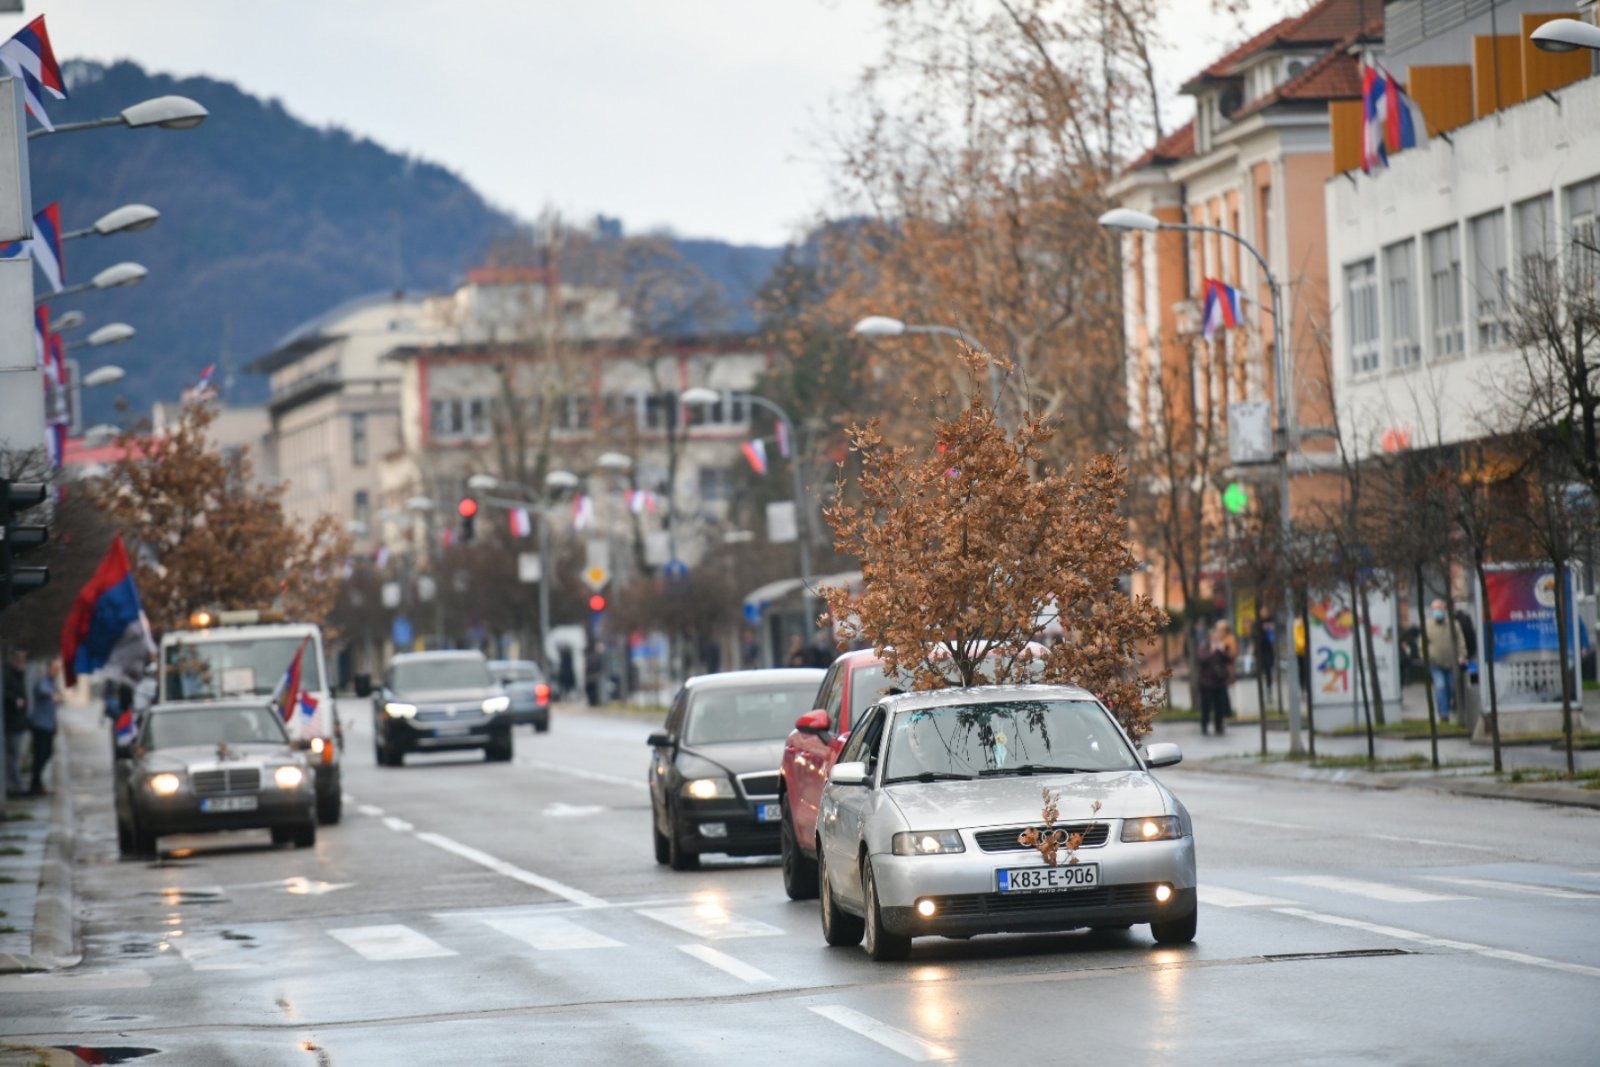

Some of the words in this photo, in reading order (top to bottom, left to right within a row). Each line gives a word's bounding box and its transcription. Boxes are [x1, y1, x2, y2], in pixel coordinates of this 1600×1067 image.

[1316, 645, 1351, 672] 20
[1321, 668, 1349, 695] 21
[1010, 868, 1094, 888] K83-E-906
